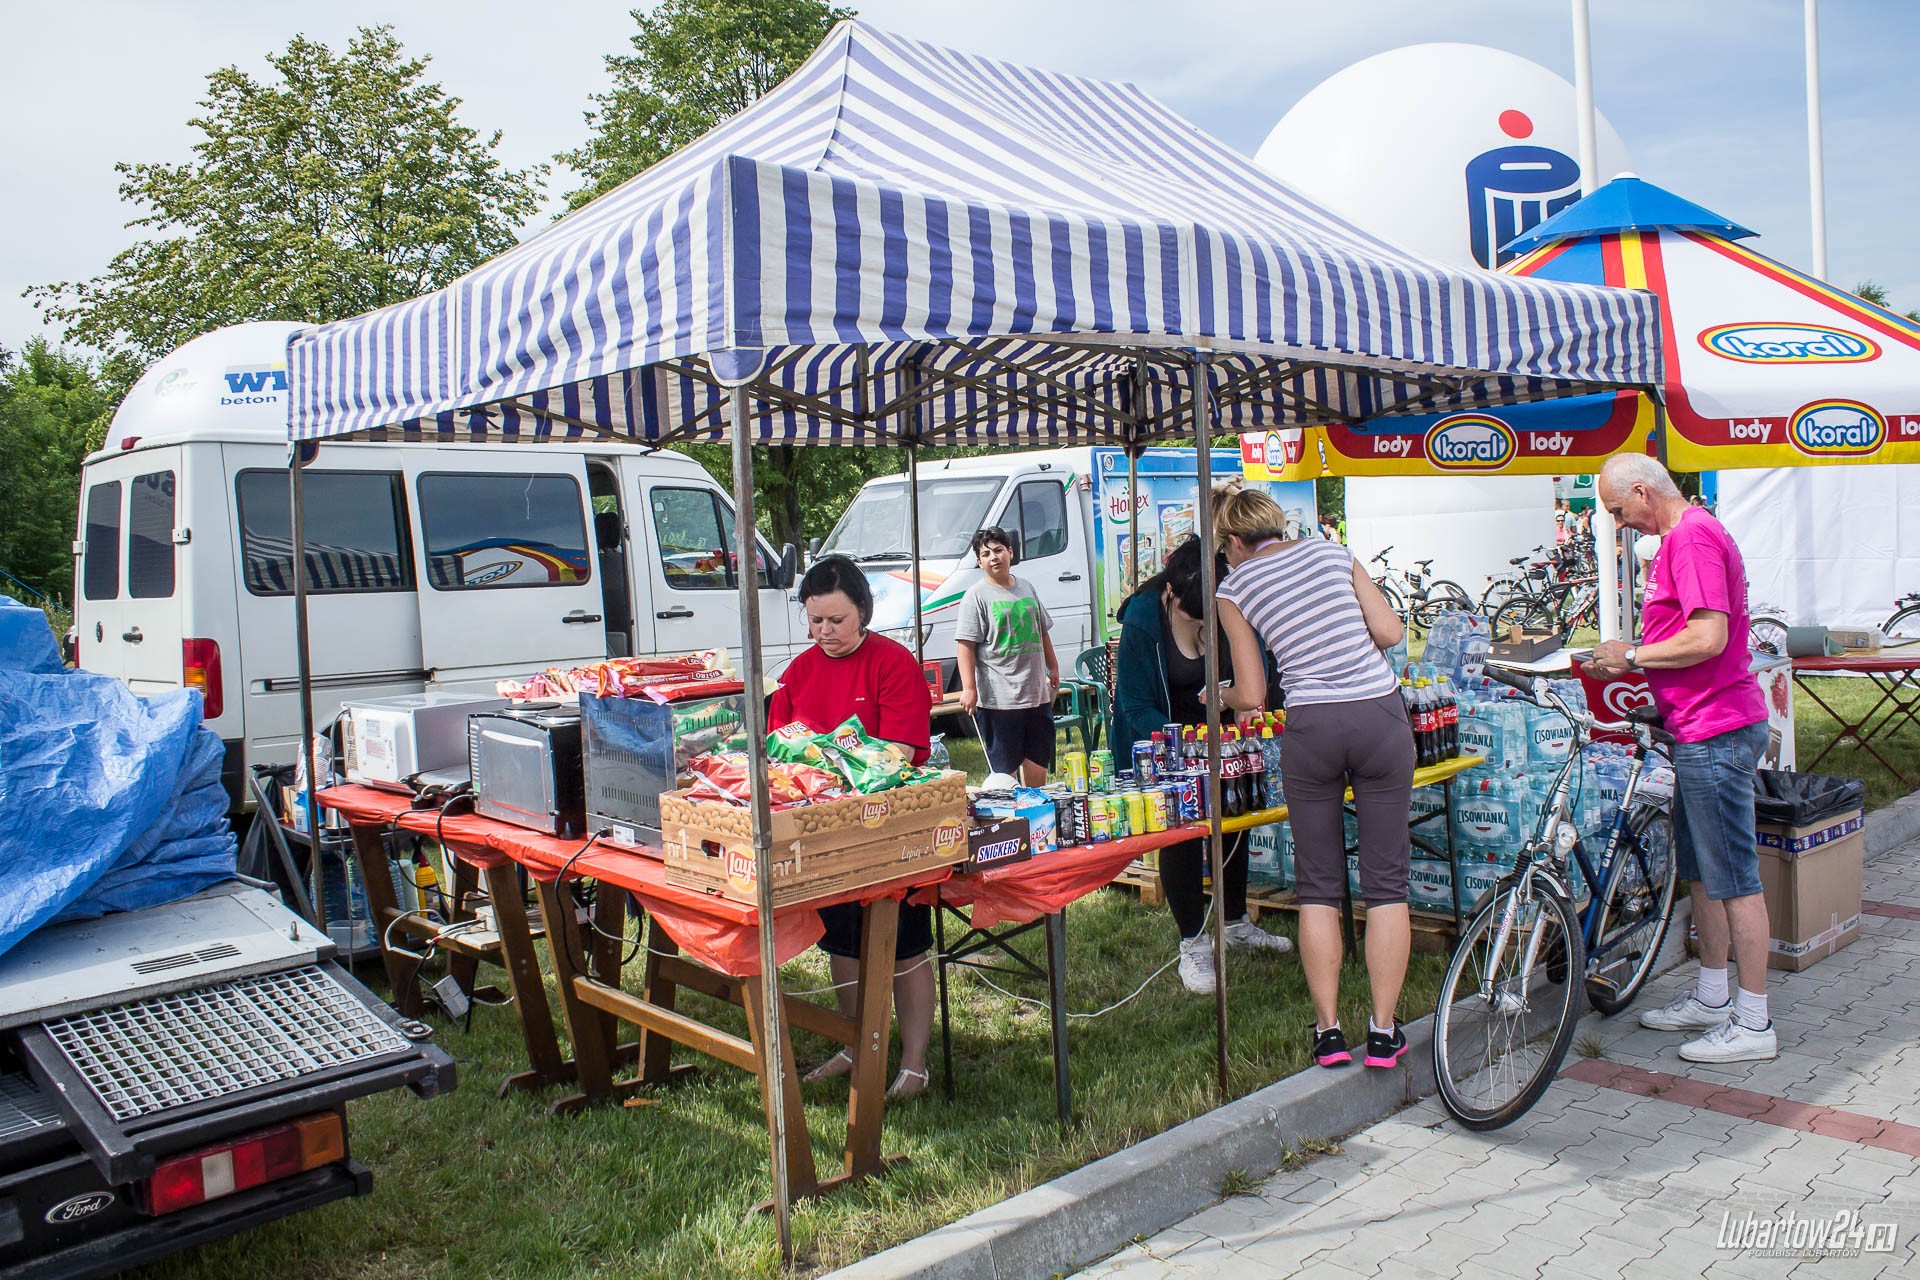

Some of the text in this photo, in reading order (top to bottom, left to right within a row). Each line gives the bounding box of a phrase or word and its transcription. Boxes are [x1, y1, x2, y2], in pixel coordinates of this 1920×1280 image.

[1725, 335, 1855, 358] koral
[221, 395, 277, 406] beton
[1729, 419, 1772, 443] lody
[1805, 418, 1870, 446] koral
[1374, 432, 1574, 461] lody koral lody
[1110, 494, 1149, 518] Hoex
[695, 669, 720, 680] BISTRO
[1460, 732, 1494, 748] OWIANKA
[1074, 800, 1087, 839] BLACK
[1456, 809, 1510, 827] CISOWIANKA
[1031, 828, 1047, 844] RALKI
[1249, 834, 1279, 851] WIANKA
[978, 839, 1020, 862] SNICKERS
[62, 1199, 101, 1220] Ford
